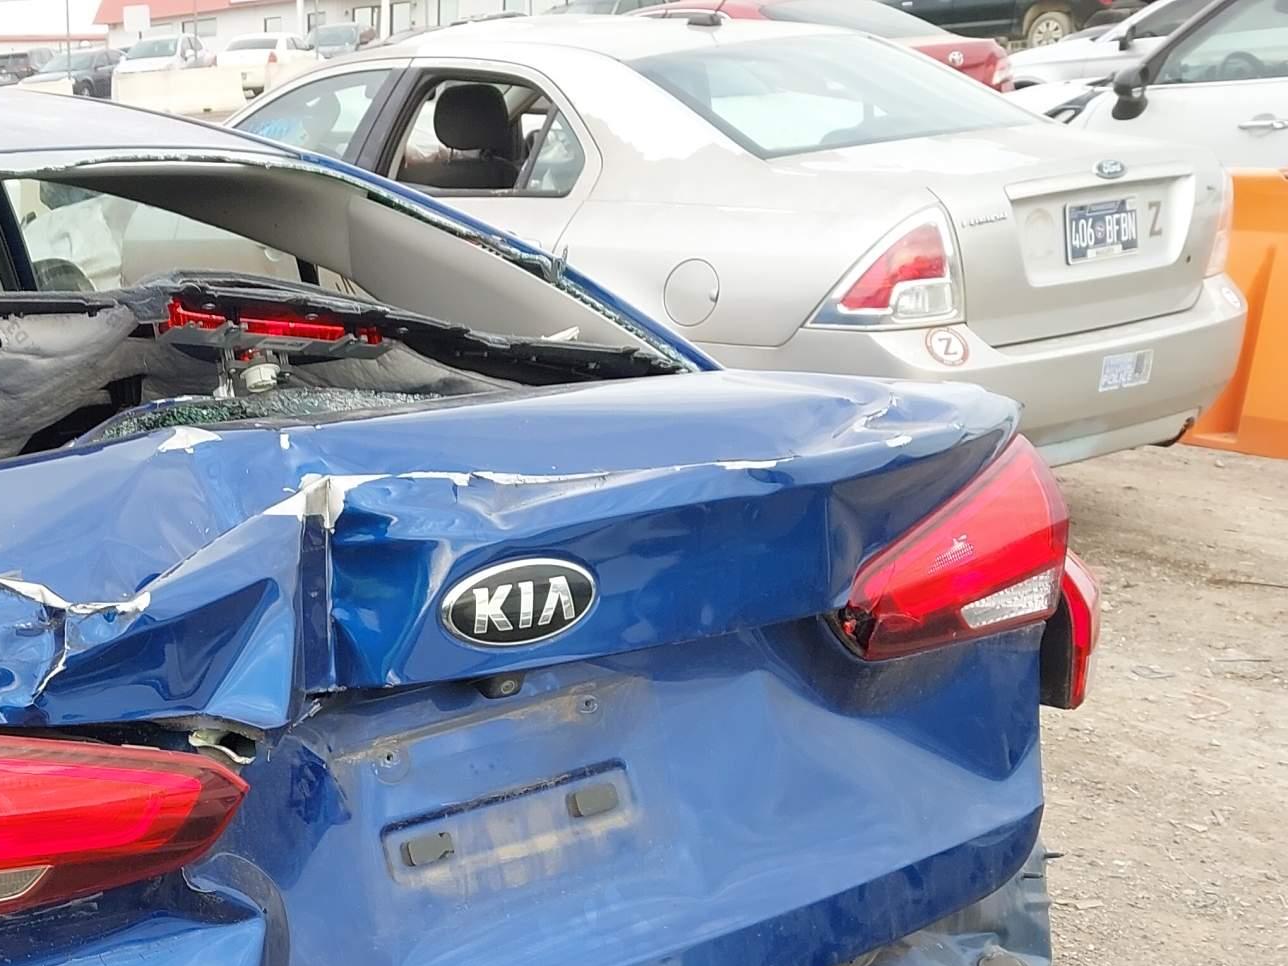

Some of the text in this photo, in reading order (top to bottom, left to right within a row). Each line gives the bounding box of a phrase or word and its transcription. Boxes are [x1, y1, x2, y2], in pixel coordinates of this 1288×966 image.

[1072, 211, 1137, 249] 406 BFBN
[1148, 201, 1163, 238] Z
[937, 336, 958, 356] Z
[472, 575, 576, 635] KIA
